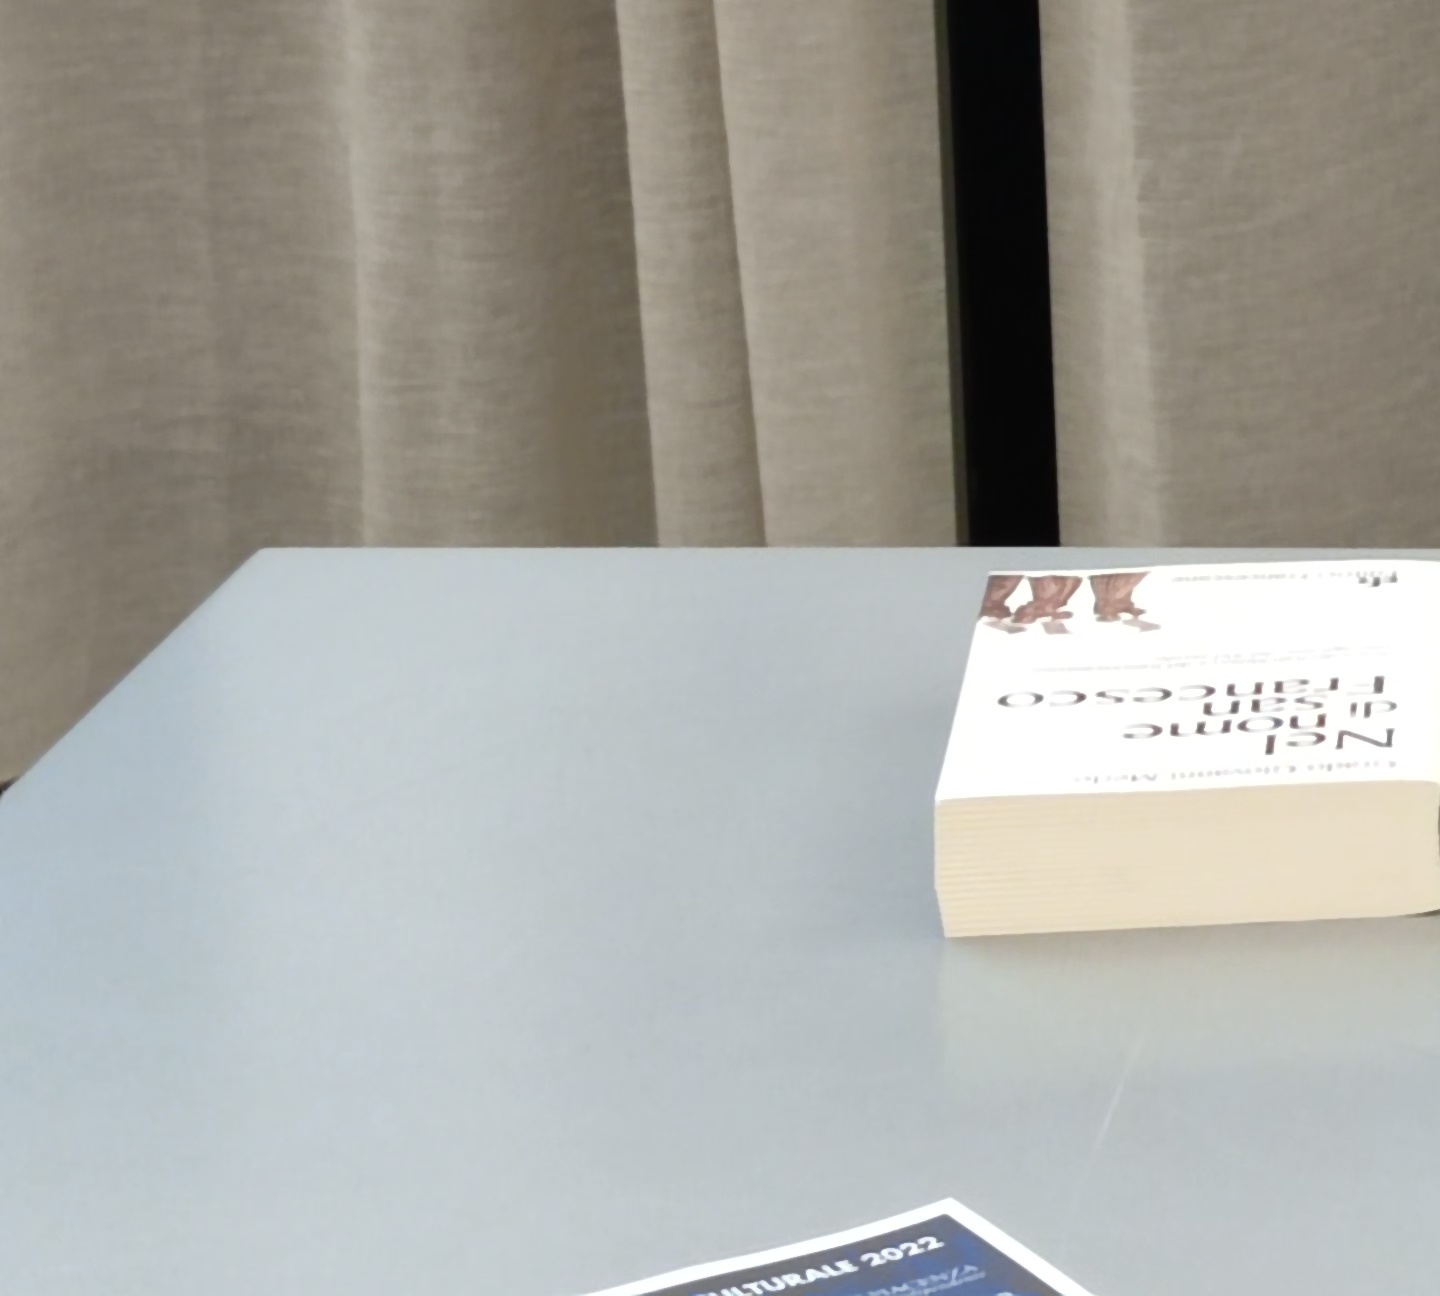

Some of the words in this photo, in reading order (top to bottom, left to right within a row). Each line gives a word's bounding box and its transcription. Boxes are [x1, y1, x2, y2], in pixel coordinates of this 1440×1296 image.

[996, 675, 1386, 709] Francesco
[1202, 693, 1329, 717] san
[1349, 699, 1399, 719] di
[1121, 712, 1328, 740] nome
[1264, 727, 1396, 756] Nel
[860, 1235, 945, 1267] 2022
